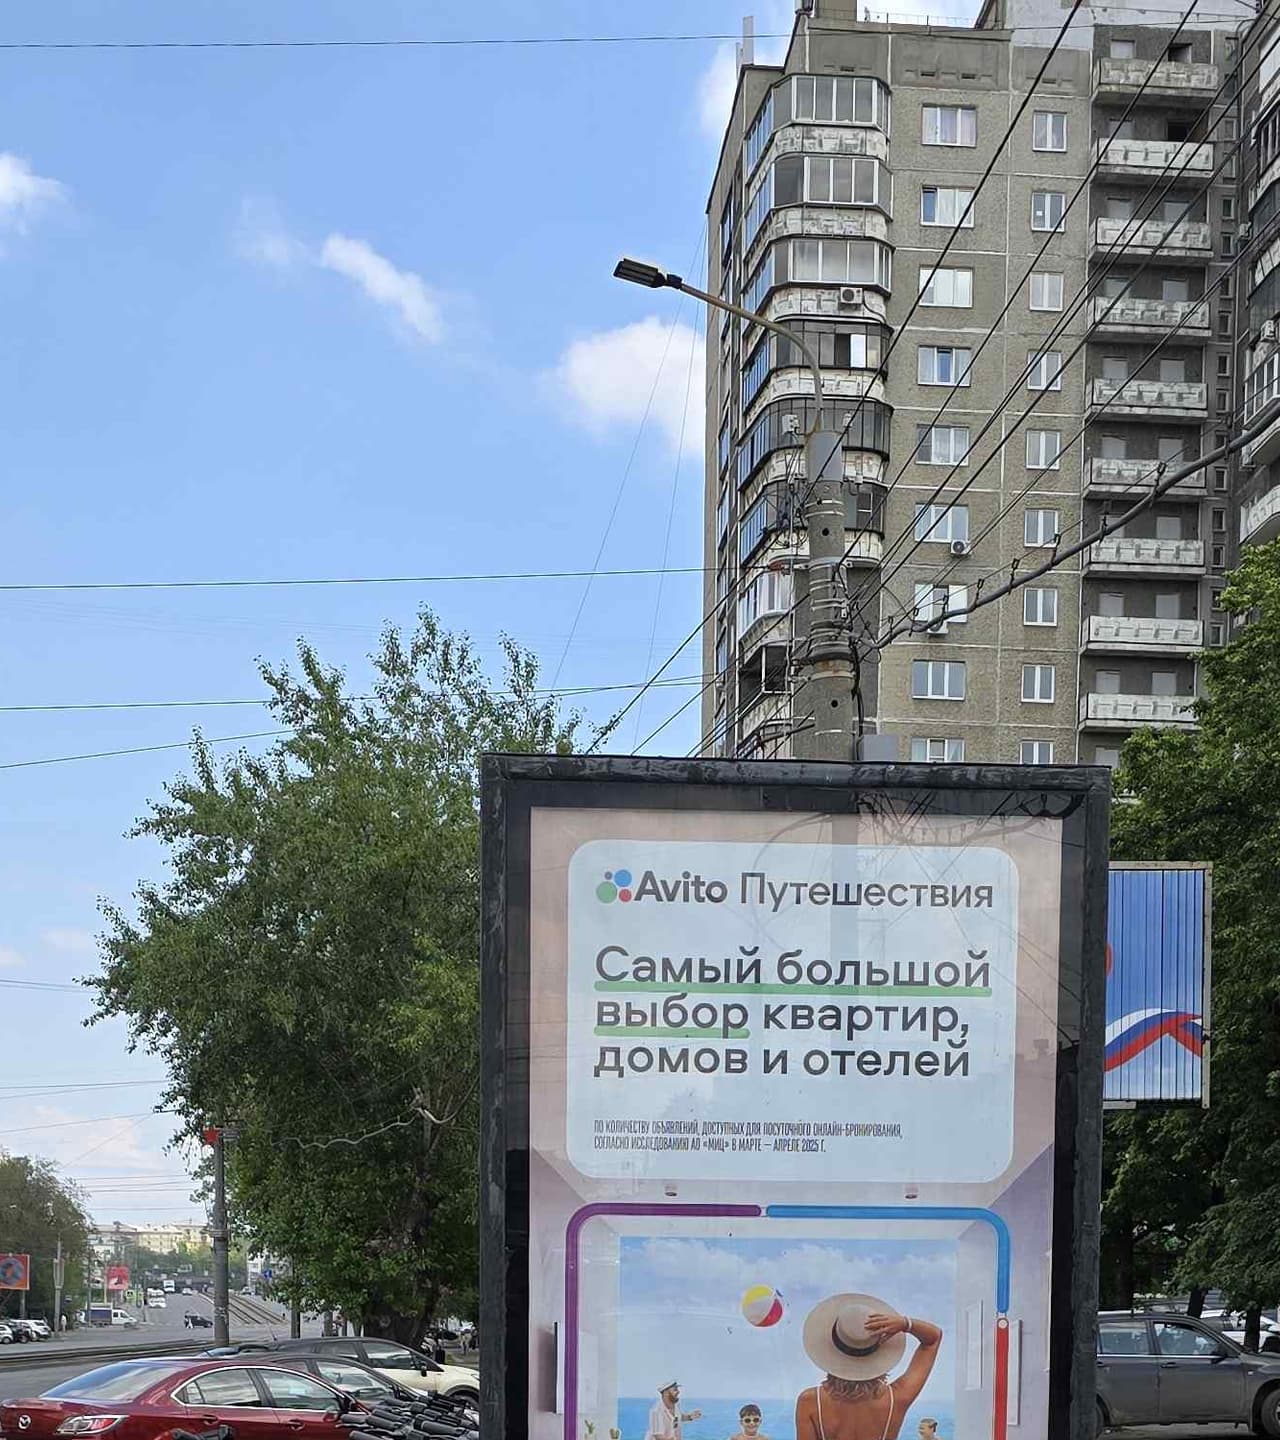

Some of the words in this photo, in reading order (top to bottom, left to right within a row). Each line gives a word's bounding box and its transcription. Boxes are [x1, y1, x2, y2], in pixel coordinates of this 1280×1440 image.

[634, 870, 728, 903] Avito
[740, 872, 993, 913] Путешествия
[595, 945, 762, 984] Самый
[776, 949, 991, 988] большой
[596, 993, 749, 1038] выбор
[763, 1002, 969, 1041] квартир,
[593, 1046, 749, 1078] домов
[763, 1049, 788, 1075] и
[803, 1039, 970, 1077] отелей
[594, 1119, 604, 1134] ПО
[605, 1119, 650, 1135] КОЛИЧЕСТВУ
[651, 1119, 700, 1136] ОБЪЯВЛЕНИЙ,
[702, 1121, 745, 1137] ДОСТУПНЫХ
[745, 1122, 761, 1137] ДЛЯ
[763, 1121, 811, 1137] ПОСУТОЧНОГО
[594, 1136, 629, 1150] СОГЛАСНО
[631, 1137, 689, 1152] ИССЛЕДОВАНИЮ
[690, 1137, 701, 1151] АО
[732, 1138, 737, 1151] В
[738, 1138, 762, 1151] МАРТЕ
[773, 1139, 800, 1152] АПРЕЛЕ
[801, 1138, 819, 1152] 2025
